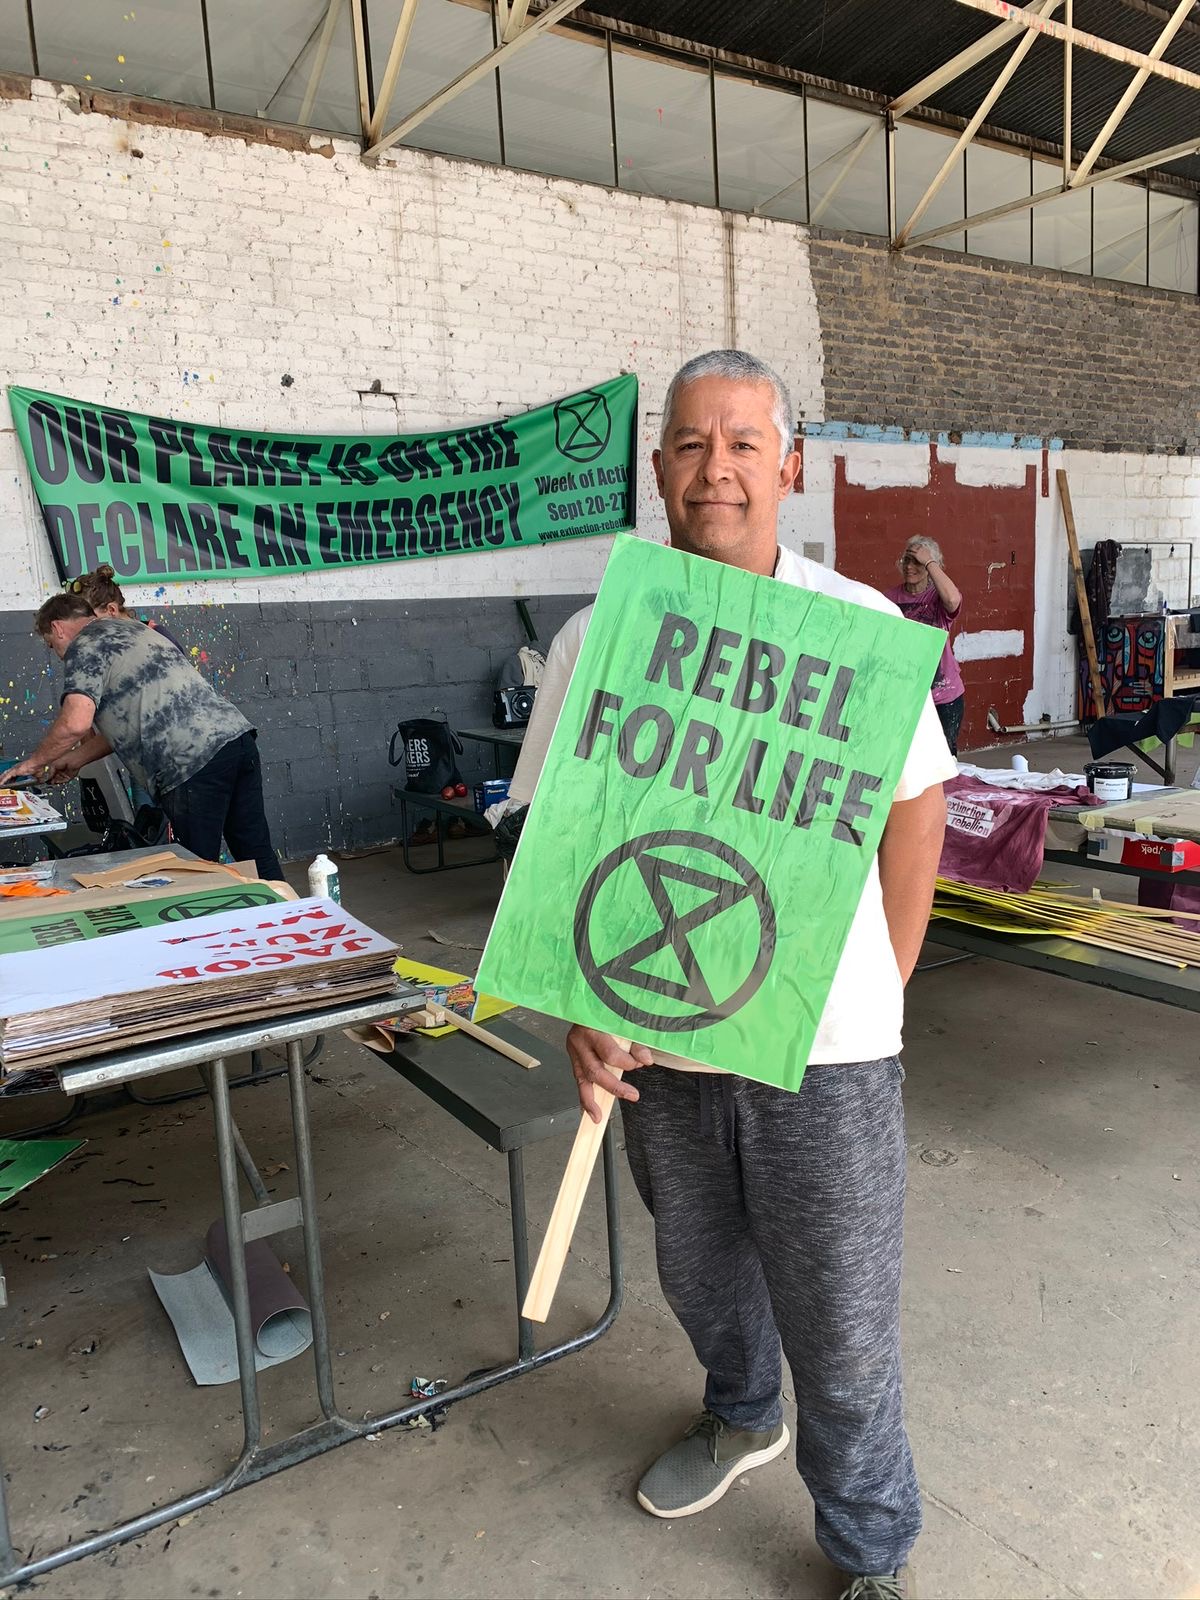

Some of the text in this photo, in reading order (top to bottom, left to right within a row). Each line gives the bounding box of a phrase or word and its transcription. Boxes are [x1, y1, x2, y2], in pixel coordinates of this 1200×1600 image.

[28, 400, 520, 487] OUR PLANET IS ON FIRE
[534, 472, 578, 496] Week
[579, 469, 595, 489] of
[547, 499, 585, 521] Sept
[43, 481, 523, 579] DECLARE AN EMERGENCY
[645, 612, 855, 742] REBEL
[574, 689, 883, 846] FOR LIFE
[947, 800, 986, 819] extinction
[951, 816, 989, 836] rebellion
[84, 905, 136, 926] LIFE
[156, 937, 373, 979] JACOB
